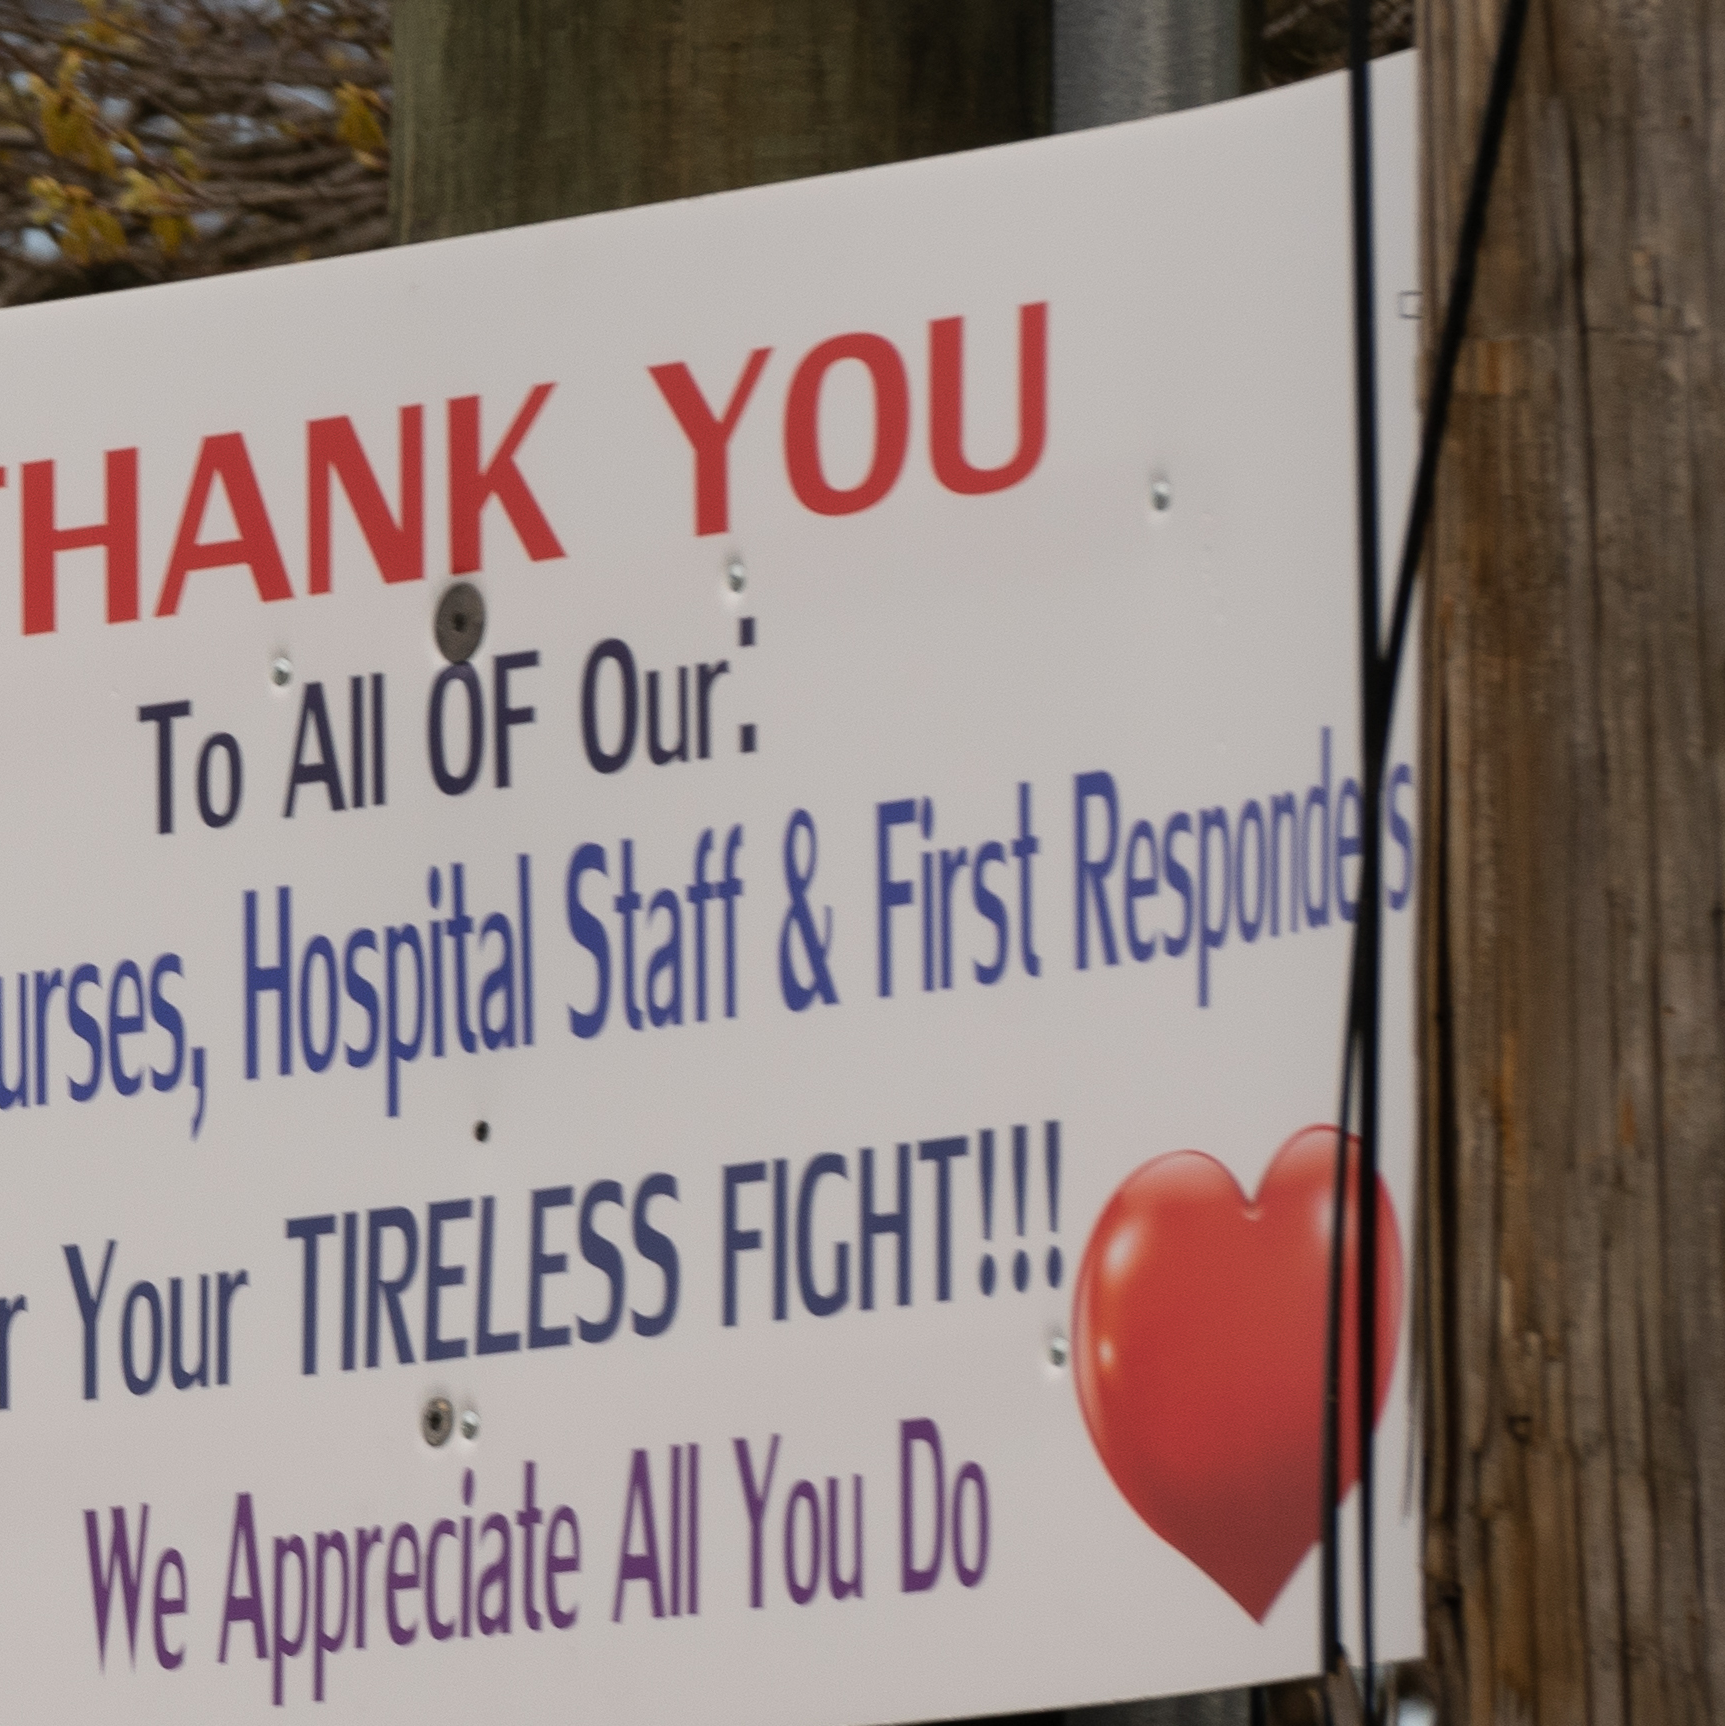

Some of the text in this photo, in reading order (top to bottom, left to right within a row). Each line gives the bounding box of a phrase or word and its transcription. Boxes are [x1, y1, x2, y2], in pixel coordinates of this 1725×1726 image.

[650, 303, 1047, 536] YOU
[139, 617, 757, 835] To All OF Our:
[245, 855, 534, 1117] Hospital
[566, 827, 743, 1039] Staff
[779, 809, 838, 1012] &
[877, 782, 1040, 997] First
[1073, 727, 1413, 1007] Respondes
[63, 1241, 248, 1400] Your
[286, 1174, 679, 1375] TIRELESS
[723, 1121, 1062, 1327] FIGHT!!!
[84, 1418, 989, 1706] We Appreciate All You Do
